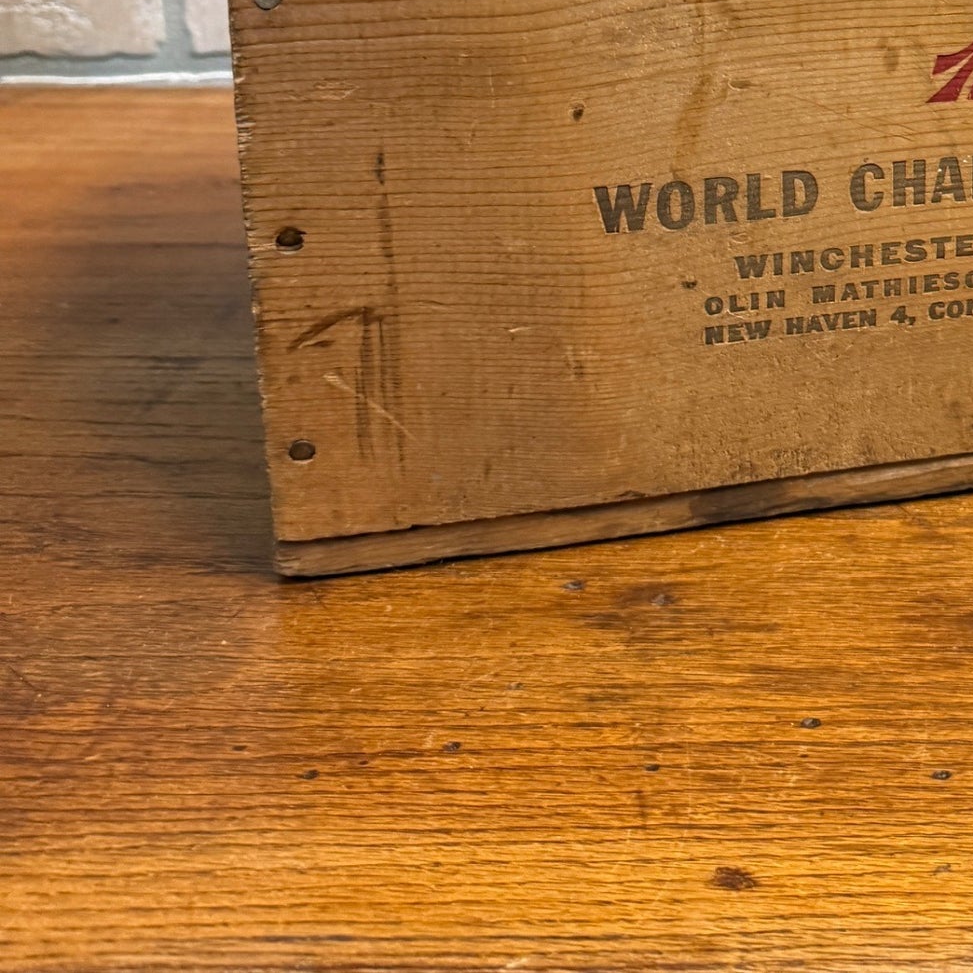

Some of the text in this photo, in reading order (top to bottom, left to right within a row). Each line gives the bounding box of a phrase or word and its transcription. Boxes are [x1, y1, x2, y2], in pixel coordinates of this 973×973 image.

[594, 169, 819, 234] WORLD
[704, 289, 786, 316] OLIN
[705, 319, 773, 346] NEW
[785, 308, 877, 336] HAVEN
[890, 305, 917, 327] 4,
